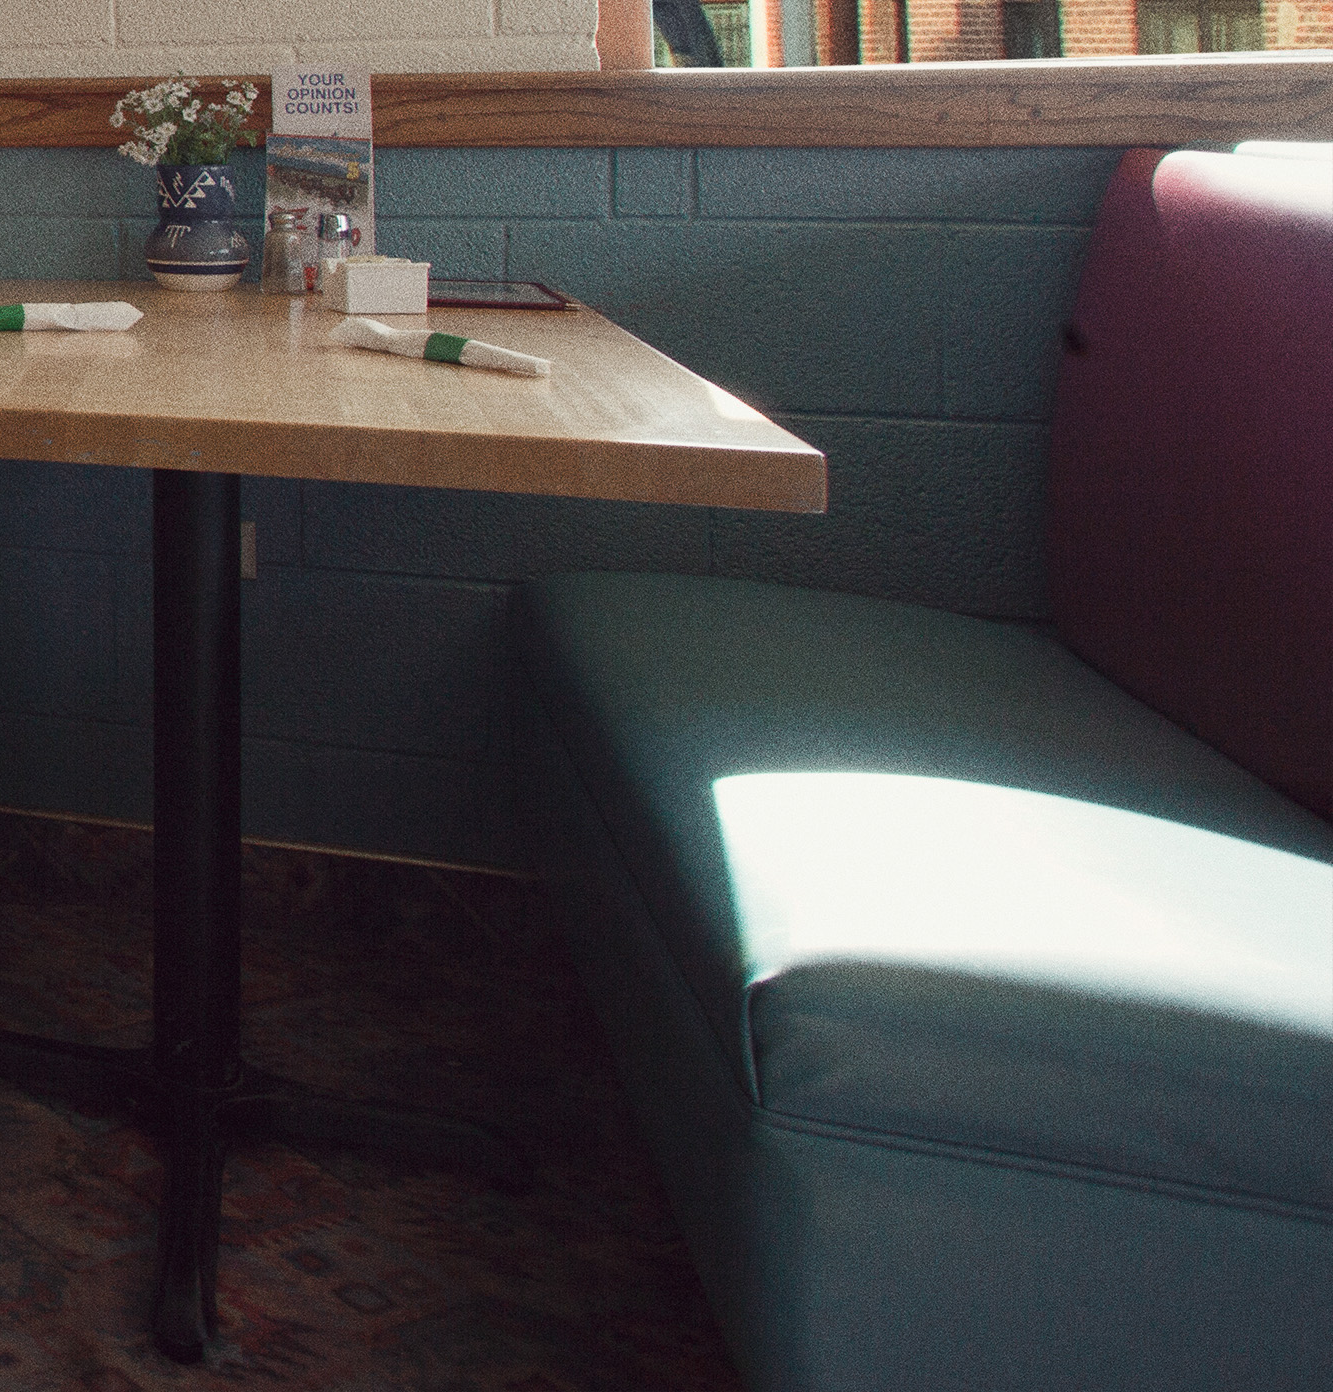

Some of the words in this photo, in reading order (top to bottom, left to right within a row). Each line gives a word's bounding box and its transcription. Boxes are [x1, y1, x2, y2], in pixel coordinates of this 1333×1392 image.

[298, 73, 345, 86] YOUR
[287, 88, 356, 100] OPINION
[285, 102, 359, 114] COUNTS!
